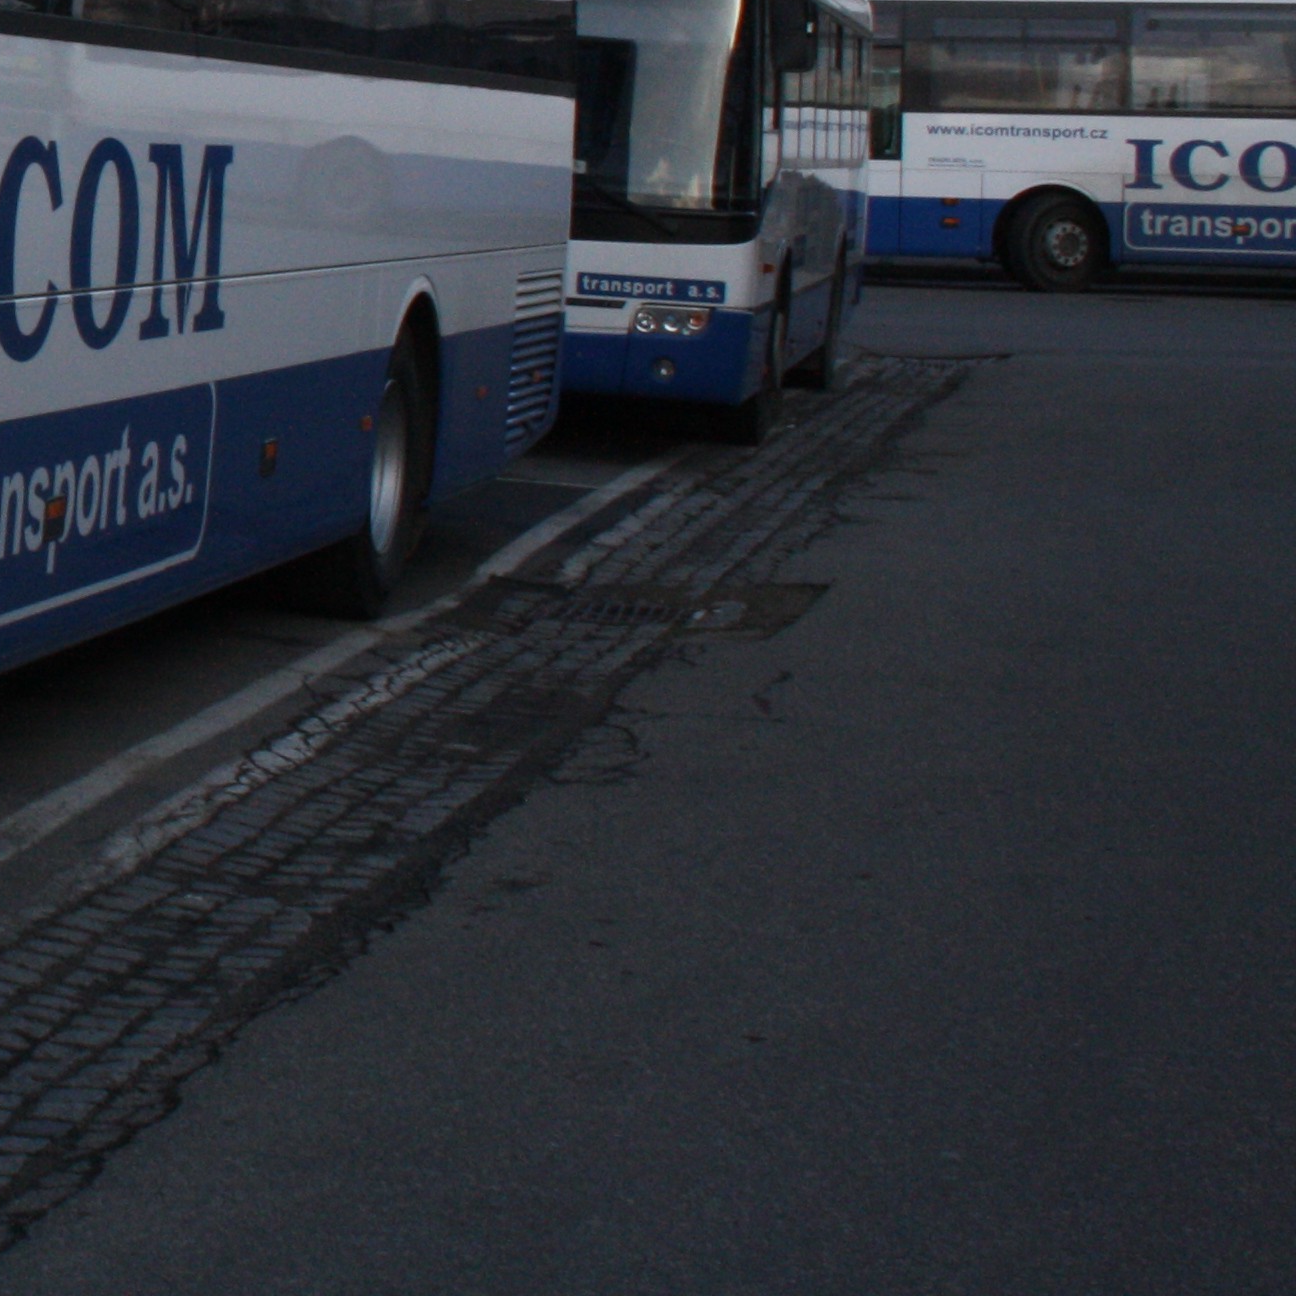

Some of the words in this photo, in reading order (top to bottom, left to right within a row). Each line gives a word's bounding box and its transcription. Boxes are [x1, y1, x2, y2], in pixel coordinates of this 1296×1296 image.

[926, 123, 1108, 140] www.icomtransport.cz
[1125, 139, 1296, 192] ICO
[582, 275, 674, 296] transport
[138, 432, 194, 521] a.s.
